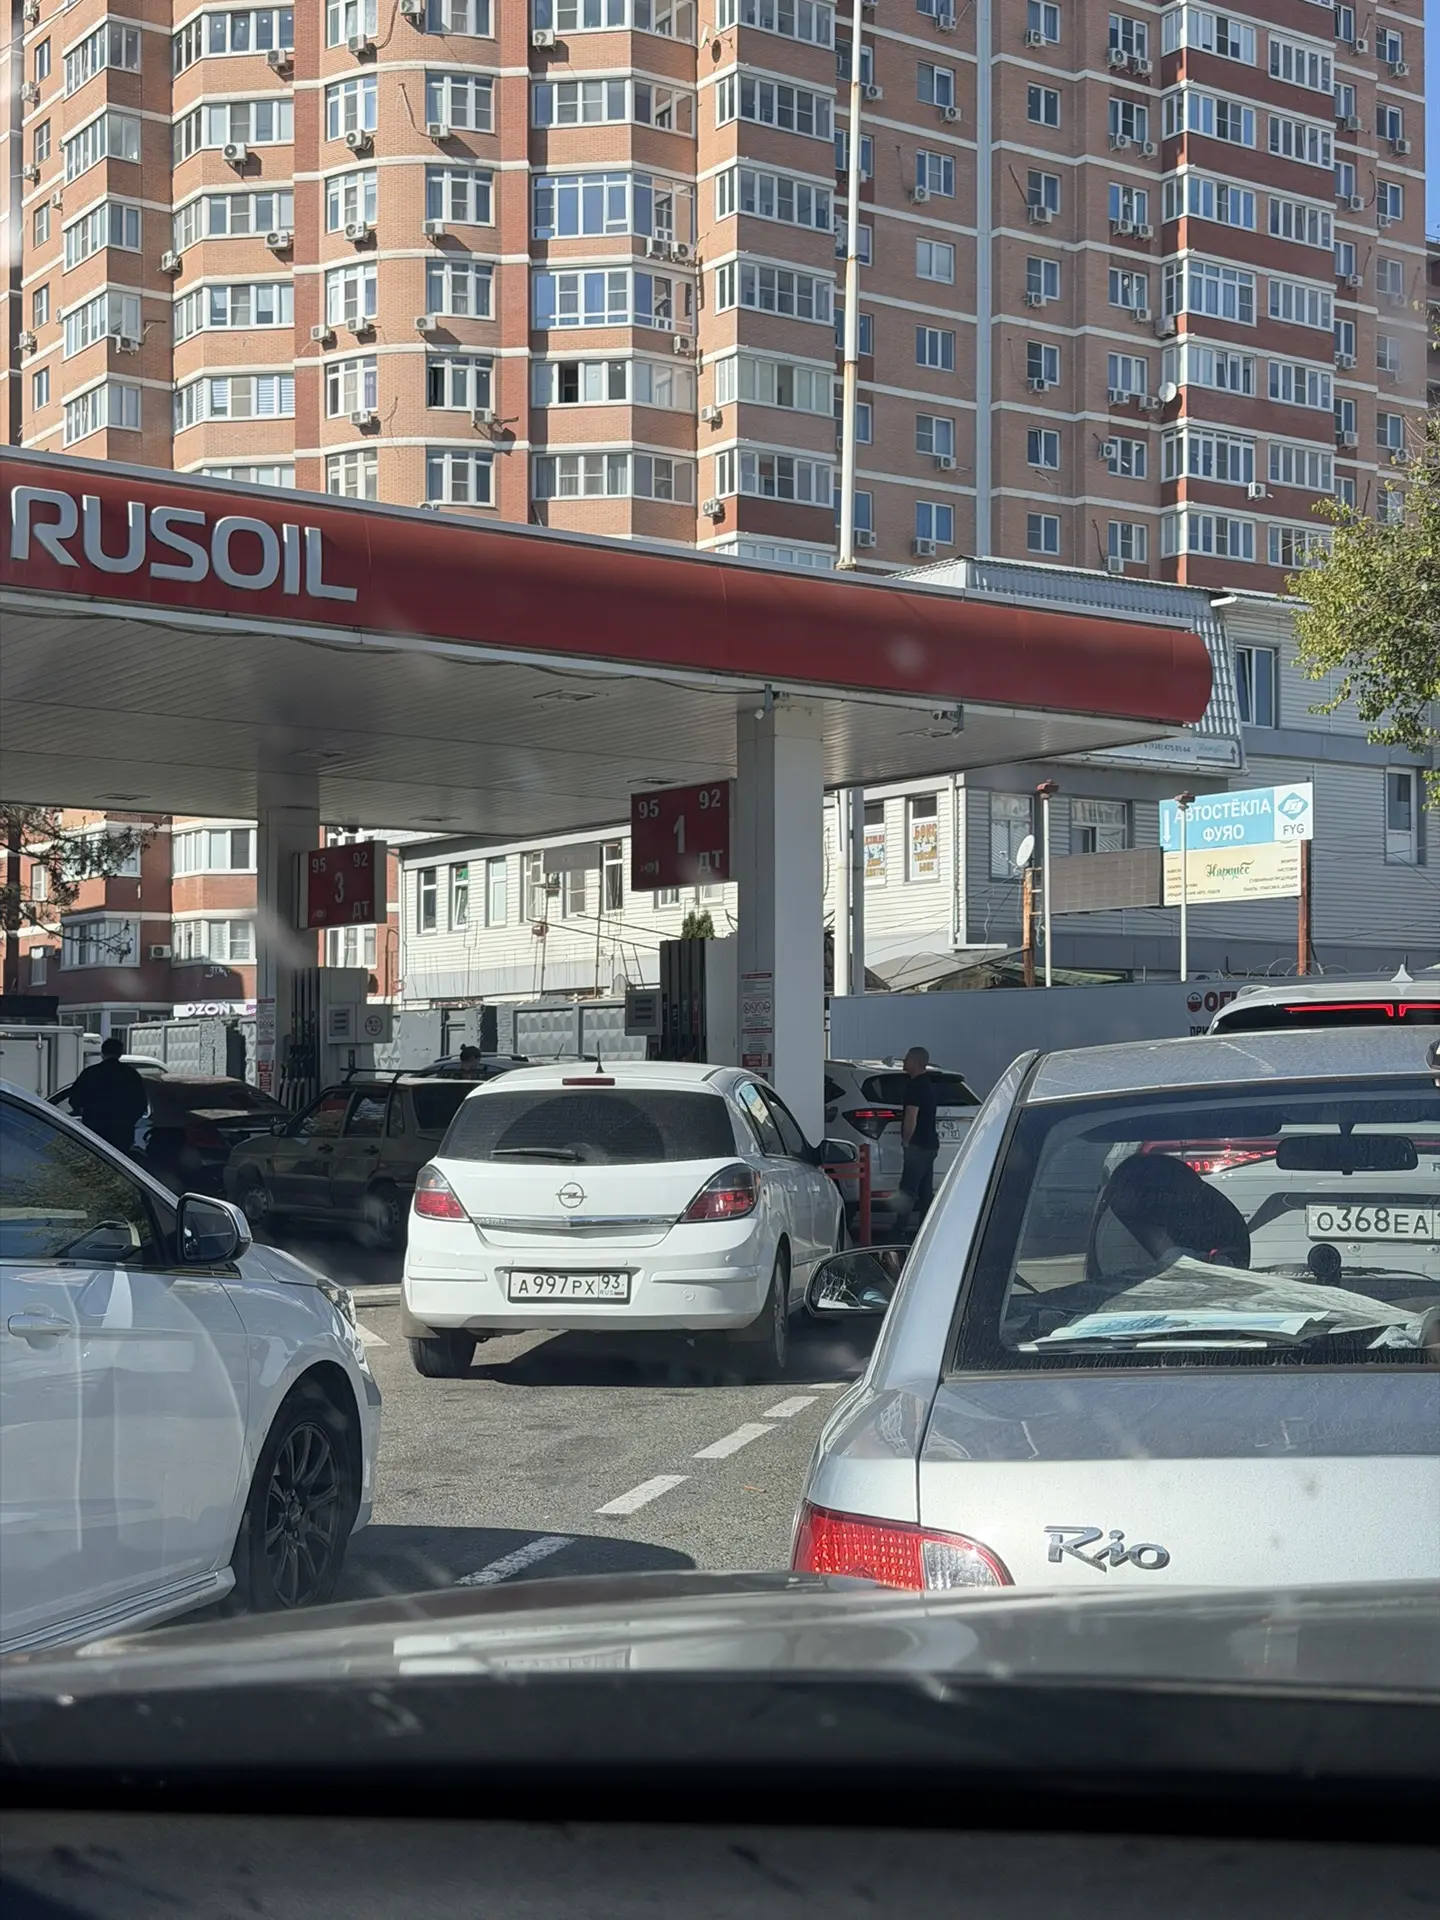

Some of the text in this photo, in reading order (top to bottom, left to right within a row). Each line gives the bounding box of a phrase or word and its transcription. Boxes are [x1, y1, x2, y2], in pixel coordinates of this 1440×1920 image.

[11, 485, 358, 602] RUSOIL
[638, 789, 721, 819] 95 92
[1174, 798, 1272, 824] АВТОСТЁКЛА
[673, 815, 686, 854] 1
[1203, 824, 1245, 842] ФУЯО
[1283, 823, 1305, 836] FYG
[311, 851, 369, 874] 95 92
[698, 849, 723, 875] ДТ
[334, 871, 345, 904] 3
[352, 900, 370, 921] ДТ
[186, 1002, 231, 1015] OZON
[518, 1274, 621, 1295] А997РХ 93
[1043, 1525, 1170, 1573] Rio
